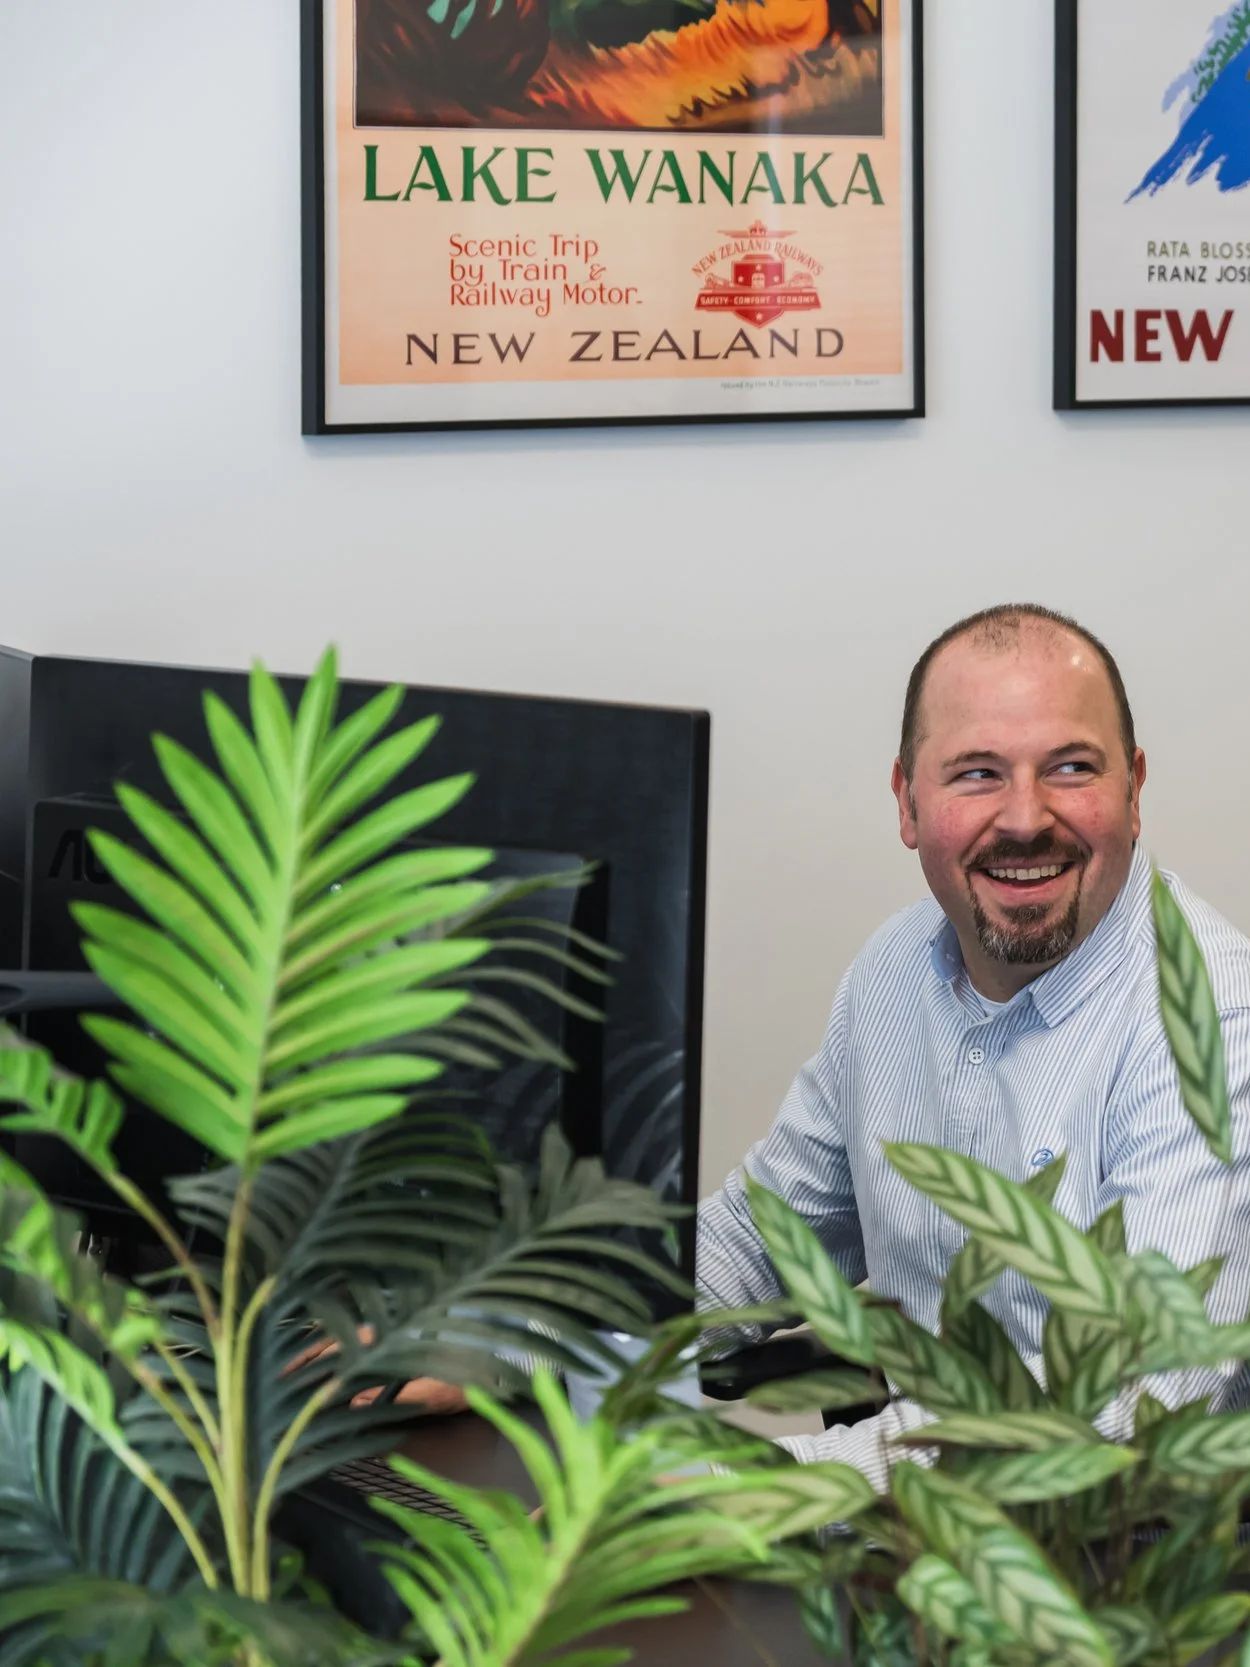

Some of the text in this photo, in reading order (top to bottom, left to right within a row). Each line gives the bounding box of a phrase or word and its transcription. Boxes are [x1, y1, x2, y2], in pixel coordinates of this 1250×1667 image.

[363, 144, 885, 208] LAKE WANAKA
[449, 233, 599, 264] Scenic Trip
[691, 239, 824, 276] NEW ZEALAND RAILWAYS
[1146, 241, 1190, 259] RATA
[450, 258, 606, 287] by Train &
[1147, 265, 1207, 283] FRANZ
[450, 282, 643, 318] Railway Motor.
[700, 295, 815, 305] SAFETY COMFORT ECONOMY
[405, 328, 844, 365] NEW ZEALAND
[1089, 309, 1234, 362] NEW
